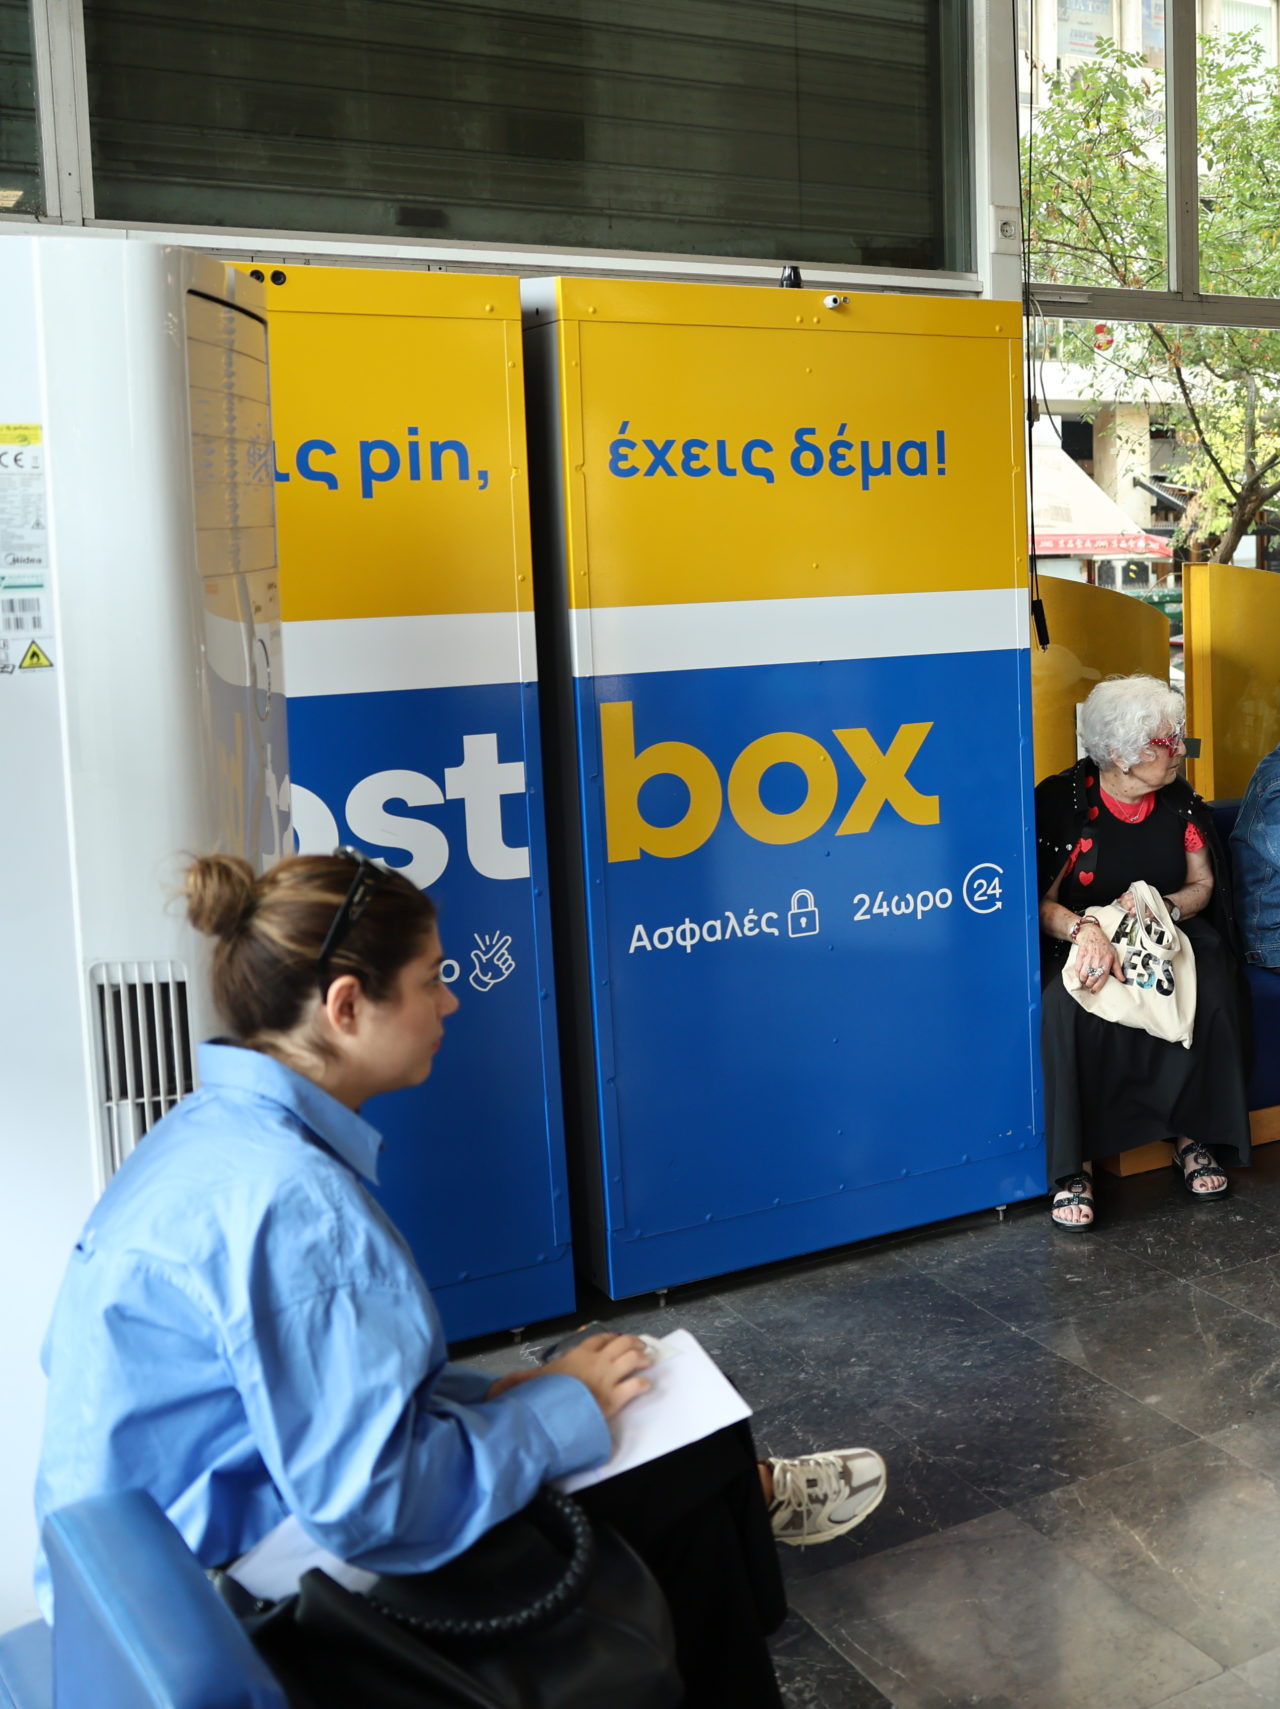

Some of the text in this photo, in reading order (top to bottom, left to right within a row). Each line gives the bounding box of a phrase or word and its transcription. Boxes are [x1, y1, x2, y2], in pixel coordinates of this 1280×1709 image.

[359, 426, 489, 499] pin,
[608, 420, 946, 491] έχεις δέμα!
[600, 700, 940, 863] box
[628, 907, 779, 954] Ασφαλές
[852, 887, 953, 921] 24ωρο
[1121, 947, 1175, 997] ESS
